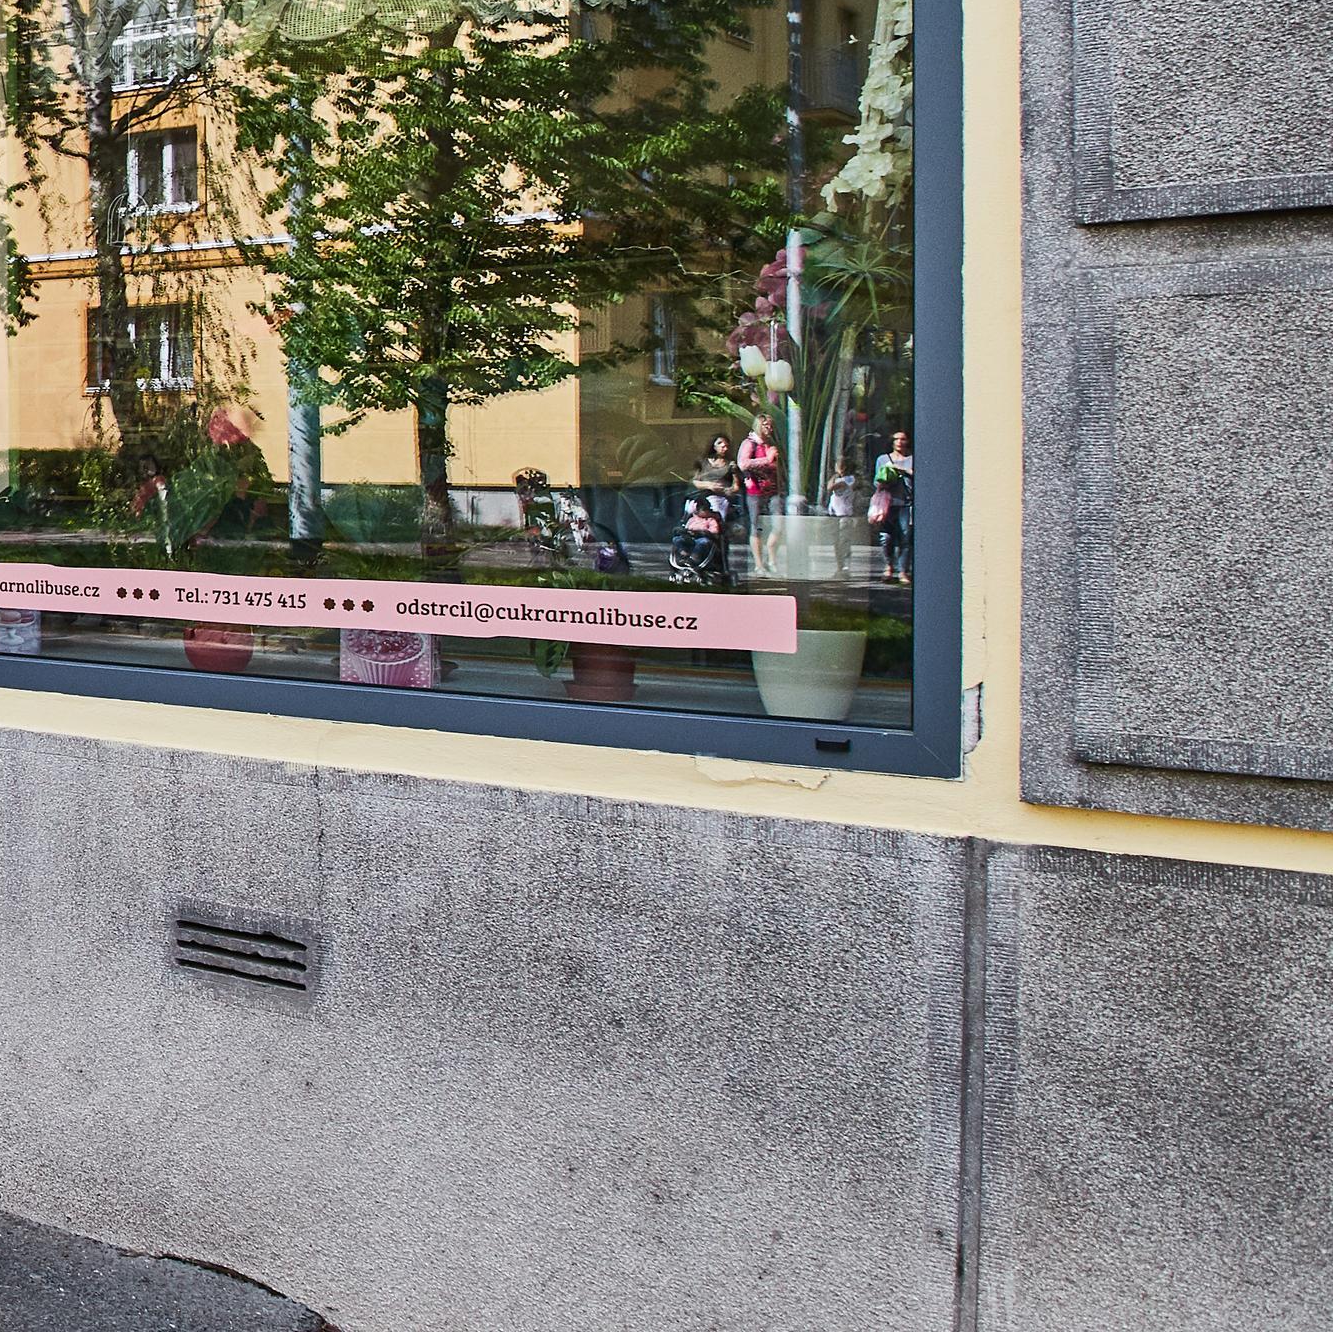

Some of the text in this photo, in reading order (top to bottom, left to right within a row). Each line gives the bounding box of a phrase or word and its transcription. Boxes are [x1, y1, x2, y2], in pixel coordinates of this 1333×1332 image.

[174, 586, 209, 604] Tel.:
[212, 589, 241, 606] 731
[244, 590, 274, 608] 475
[277, 592, 307, 610] 415
[395, 598, 699, 631] odstrcil@cukrarnalibuse.cz
